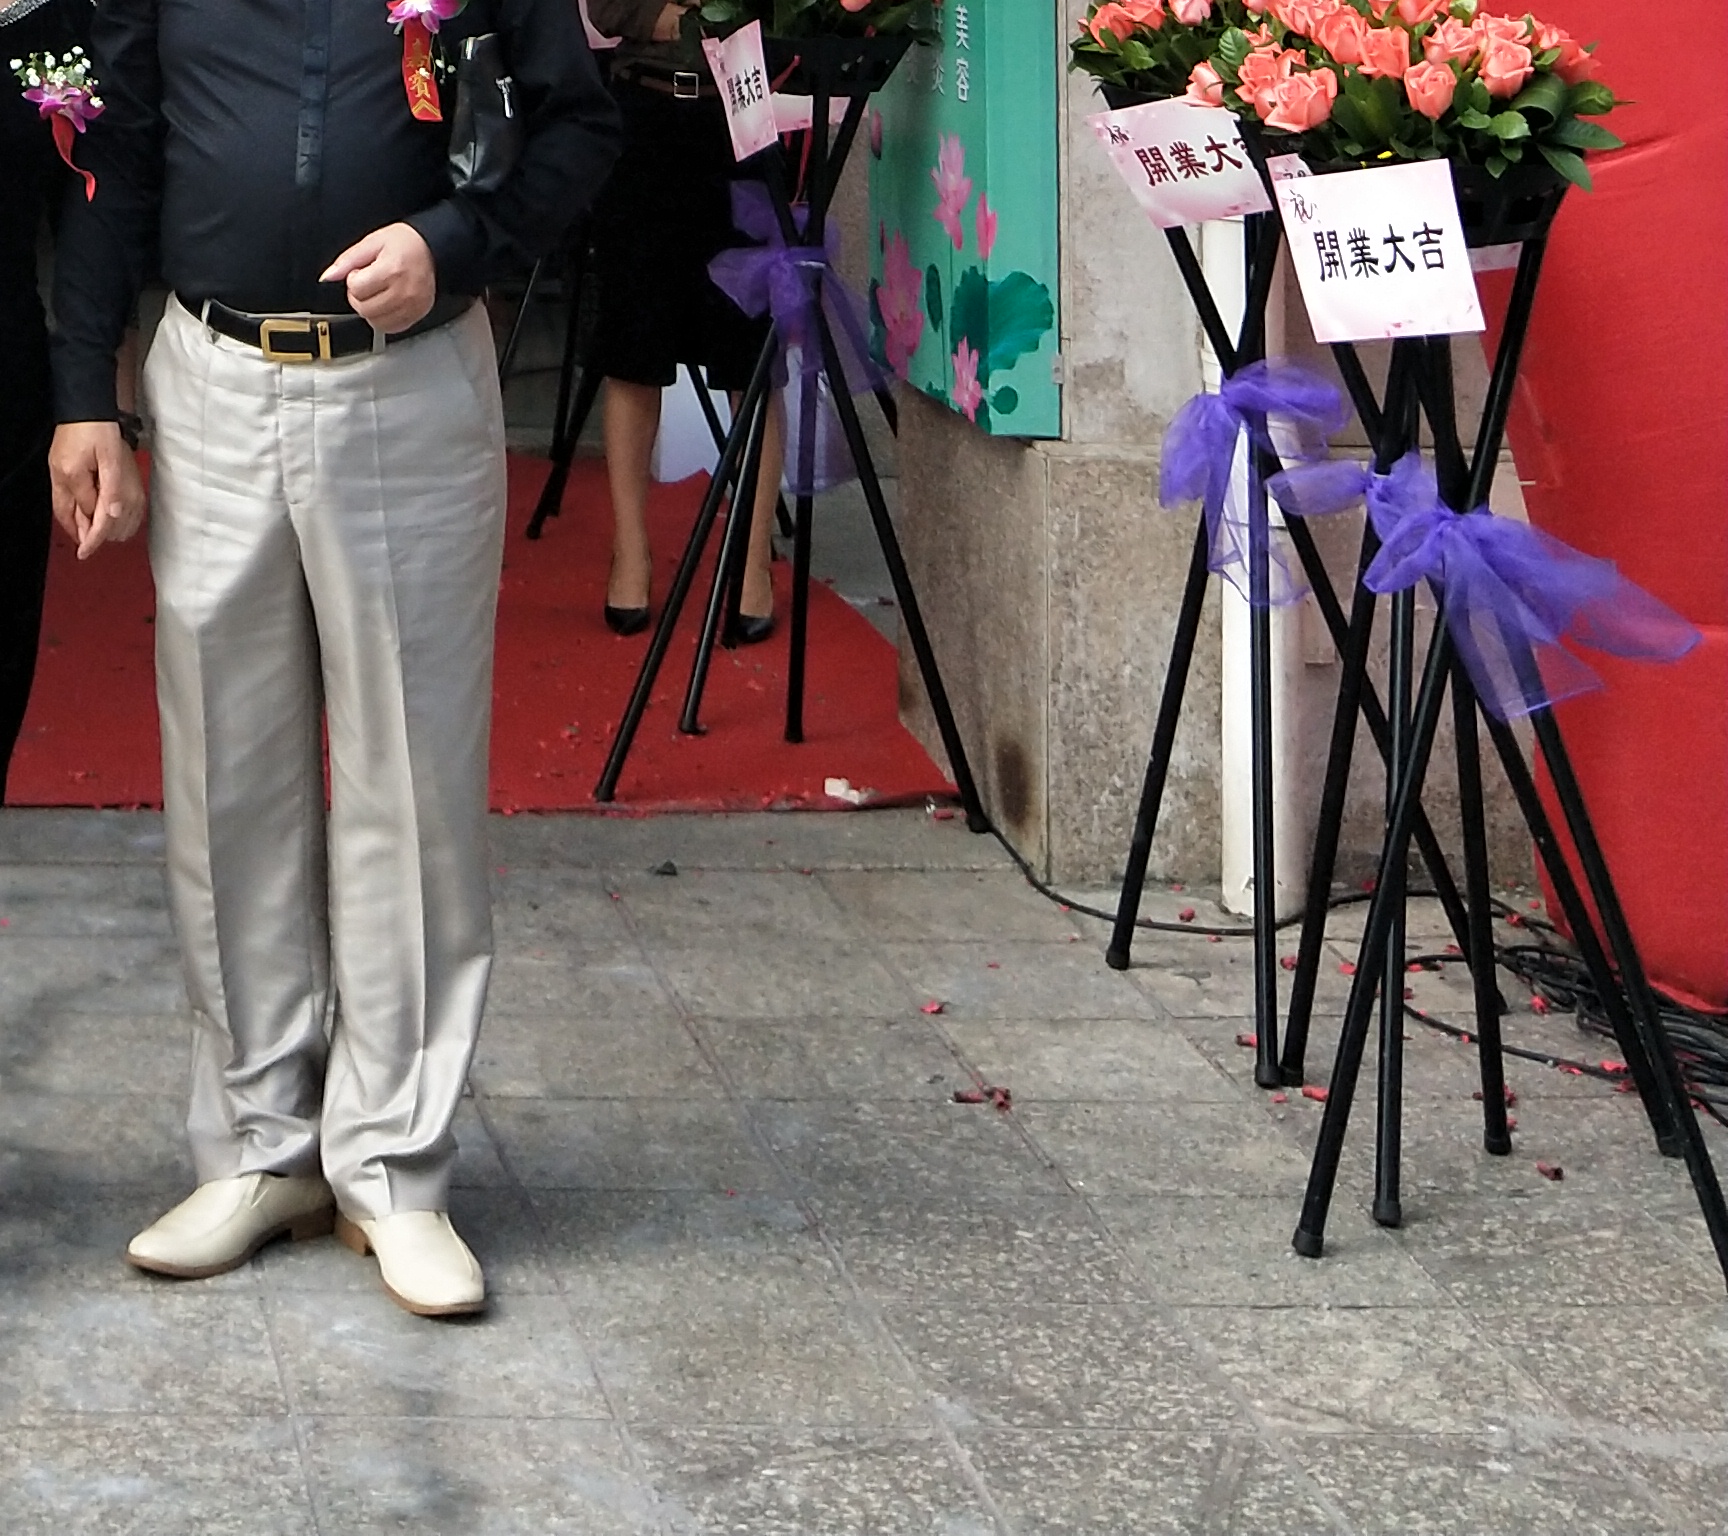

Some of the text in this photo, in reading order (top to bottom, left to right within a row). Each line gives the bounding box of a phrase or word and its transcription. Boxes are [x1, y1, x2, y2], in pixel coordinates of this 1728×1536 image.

[1133, 134, 1248, 187] 開業大
[1311, 221, 1445, 284] 開業大吉
